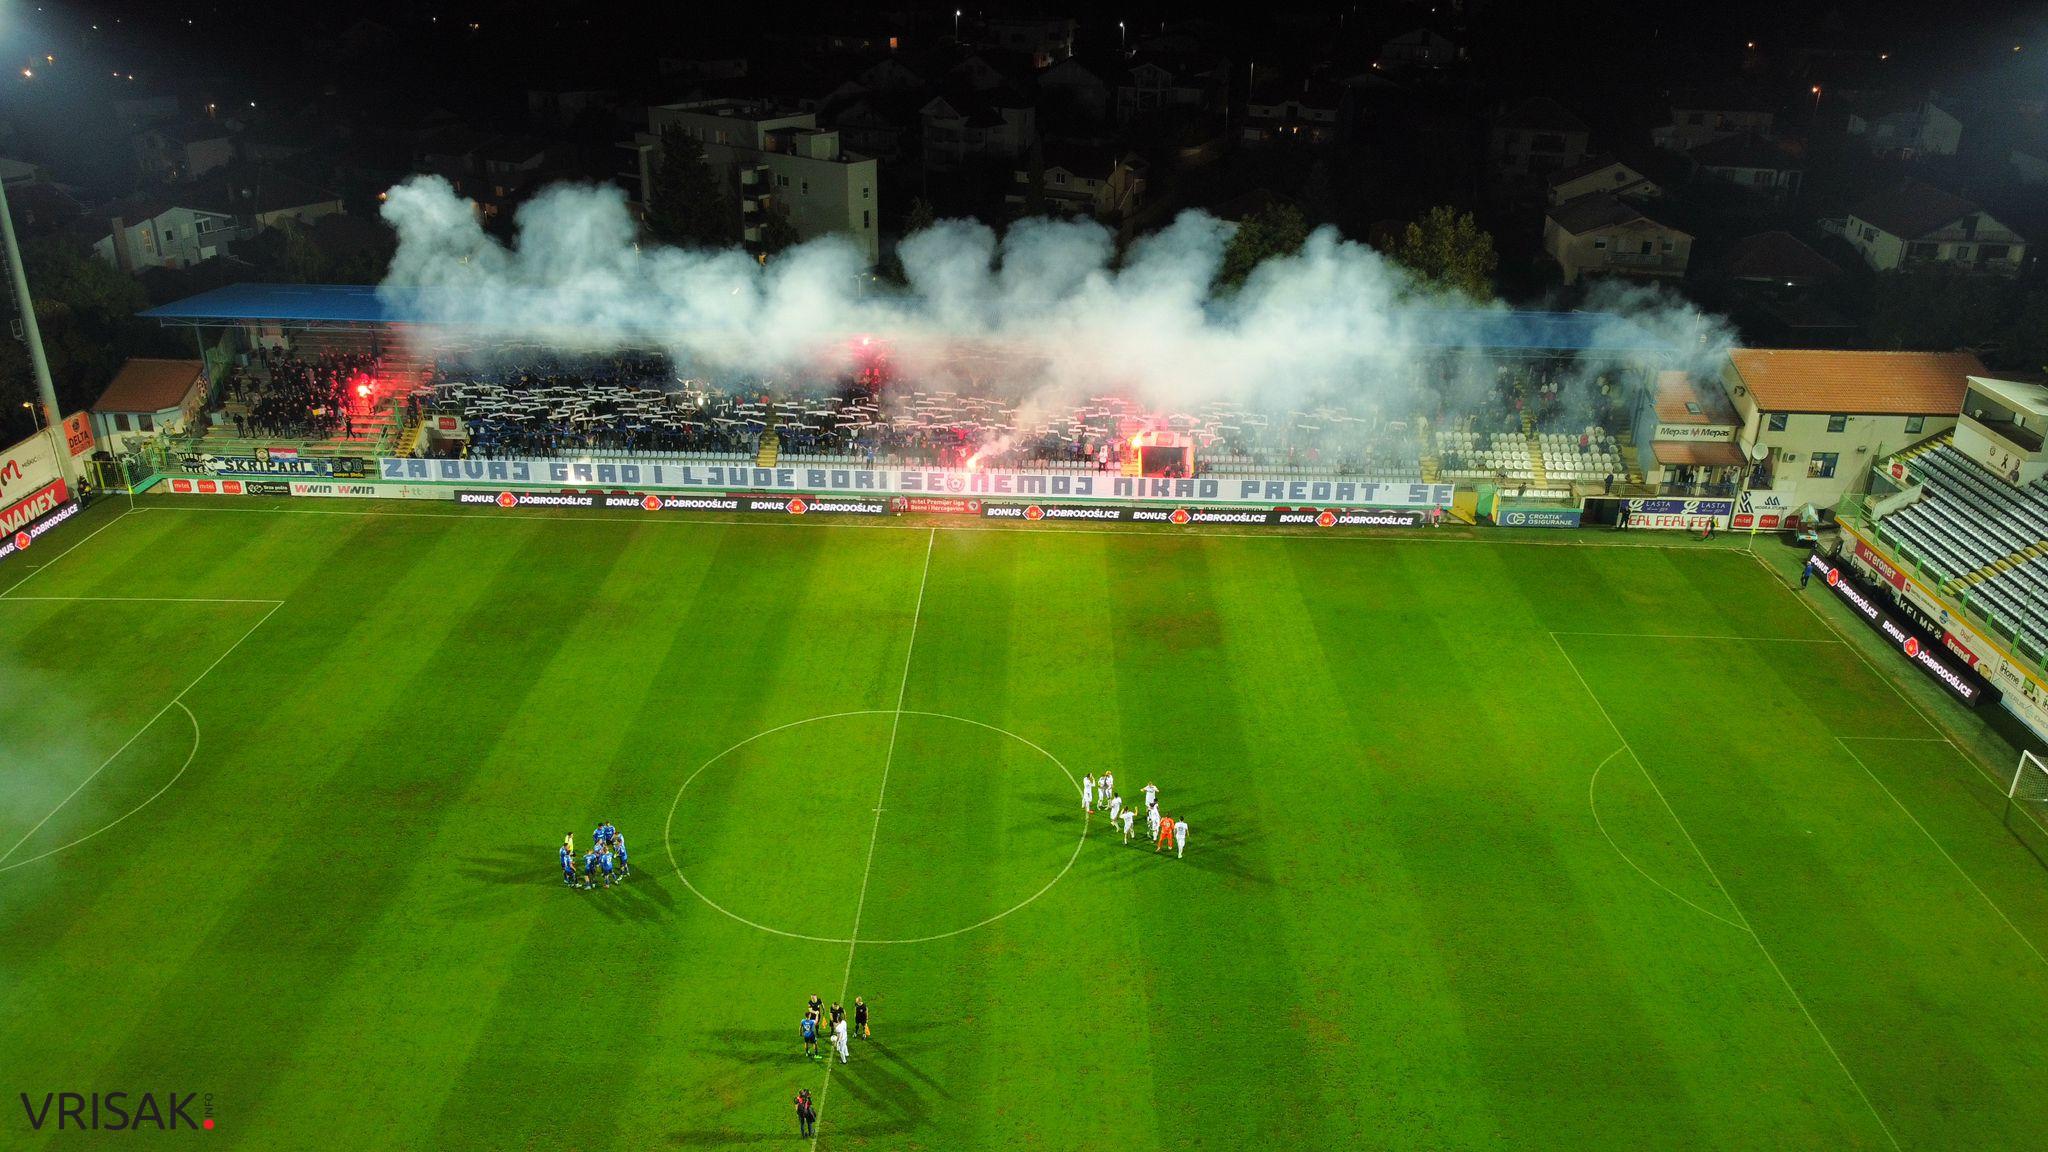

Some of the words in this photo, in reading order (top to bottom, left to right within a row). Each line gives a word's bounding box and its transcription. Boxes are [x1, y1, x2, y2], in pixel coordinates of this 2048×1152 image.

[69, 430, 89, 449] DELTA
[1660, 427, 1689, 437] Mepas
[1701, 428, 1730, 438] Mepas
[224, 459, 306, 474] SKRIPARI
[383, 458, 427, 478] ZA
[440, 460, 530, 481] OVAJ
[549, 463, 640, 484] GRAD
[653, 465, 663, 484] I
[683, 466, 794, 487] LJUDE
[807, 469, 887, 489] BORI
[901, 472, 944, 492] SE
[1114, 478, 1218, 498] NIKAD
[1409, 484, 1453, 503] SE
[461, 494, 495, 503] BONUS
[519, 495, 592, 506] DOBRODOŠLICE
[606, 498, 640, 507] BONUS
[665, 499, 738, 509] DOBRODOŠLICE
[751, 501, 784, 511] BONUS
[810, 502, 883, 513] DOBRODOŠLICE
[0, 488, 58, 538] NAMEX
[30, 504, 78, 538] DOBRODOŠLICE
[988, 507, 1021, 517] BONUS
[1047, 508, 1120, 519] DOBRODOŠLICE
[1133, 511, 1167, 520] BONUS
[1193, 512, 1267, 522] DOBRODOŠLICE
[1280, 514, 1313, 524] BONUS
[1339, 516, 1413, 526] DOBRODOŠLICE
[1810, 555, 1829, 575] BONUS
[1837, 580, 1878, 620] DOBRODOŠLICE
[1882, 620, 1905, 643] BONUS
[1917, 650, 1973, 698] DOBRODOŠLICE
[1947, 638, 1971, 663] trend
